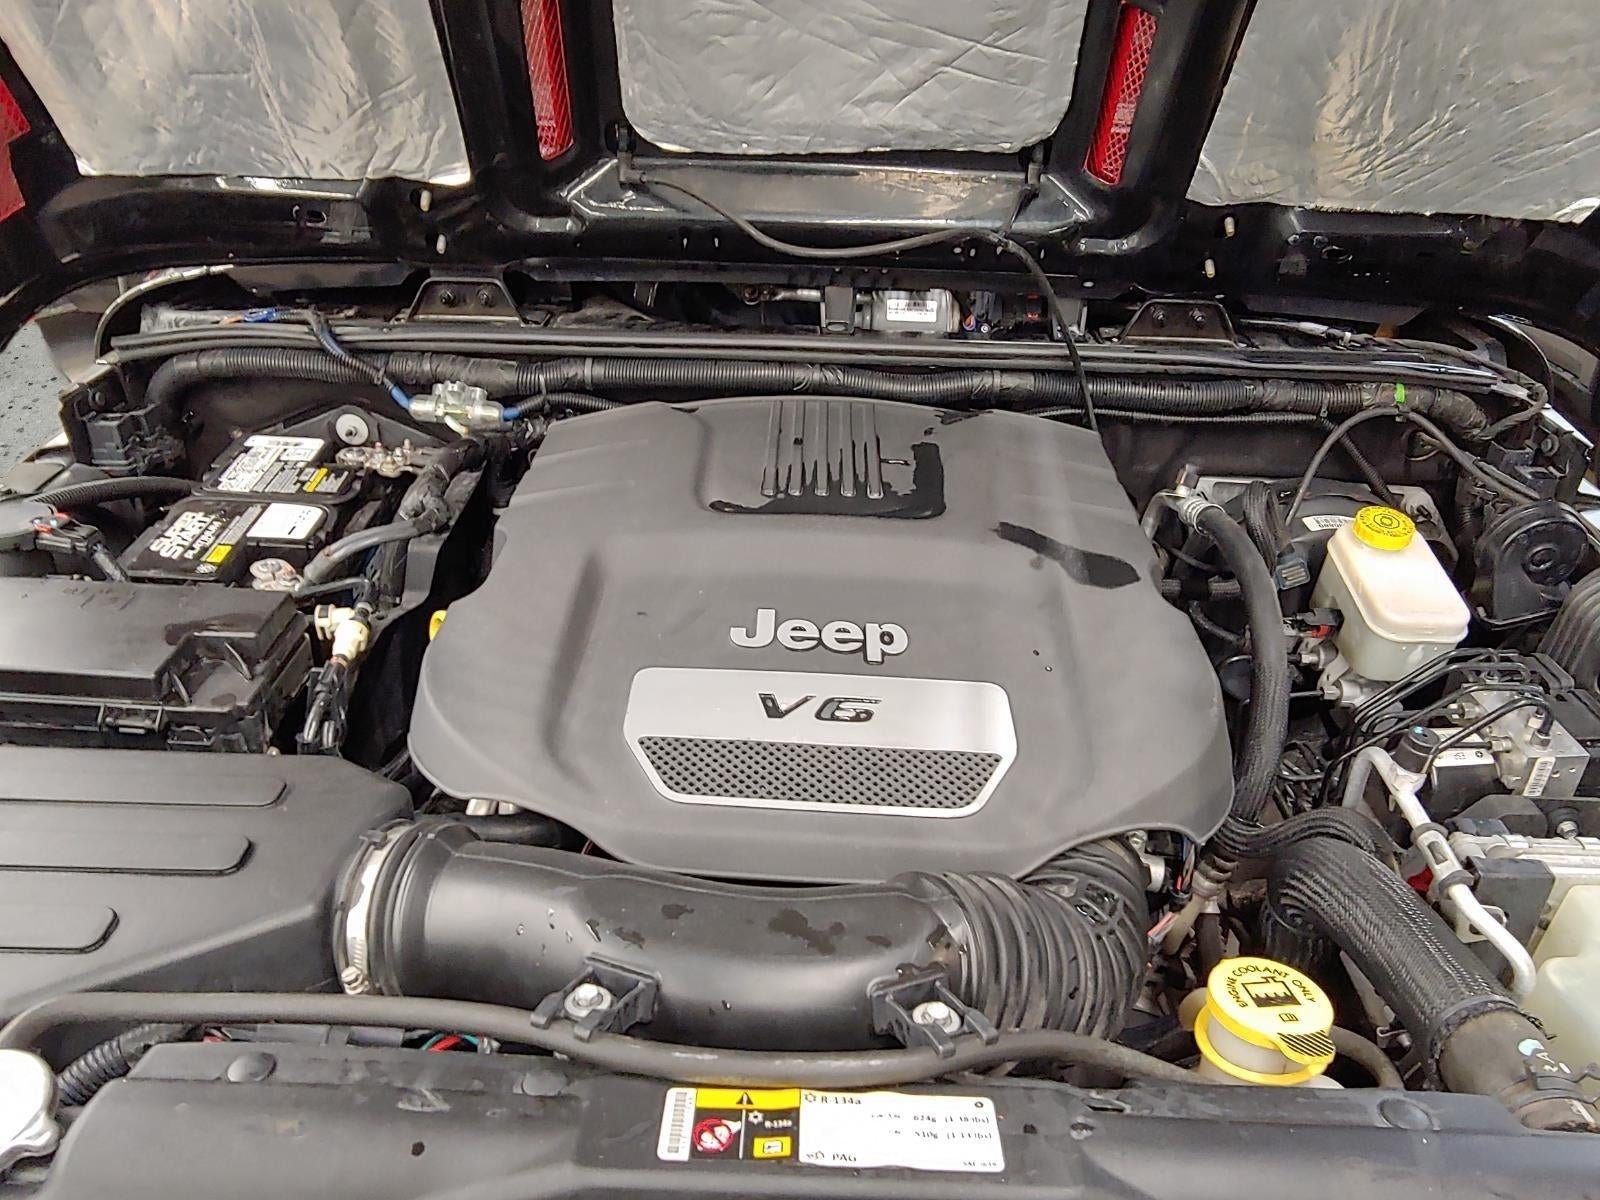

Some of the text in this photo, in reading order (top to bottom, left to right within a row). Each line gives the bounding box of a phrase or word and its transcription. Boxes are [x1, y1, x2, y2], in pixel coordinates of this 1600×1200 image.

[729, 608, 909, 665] Jeep
[758, 693, 882, 723] V6
[1225, 965, 1317, 1008] ENGINE COOLANT ONLY
